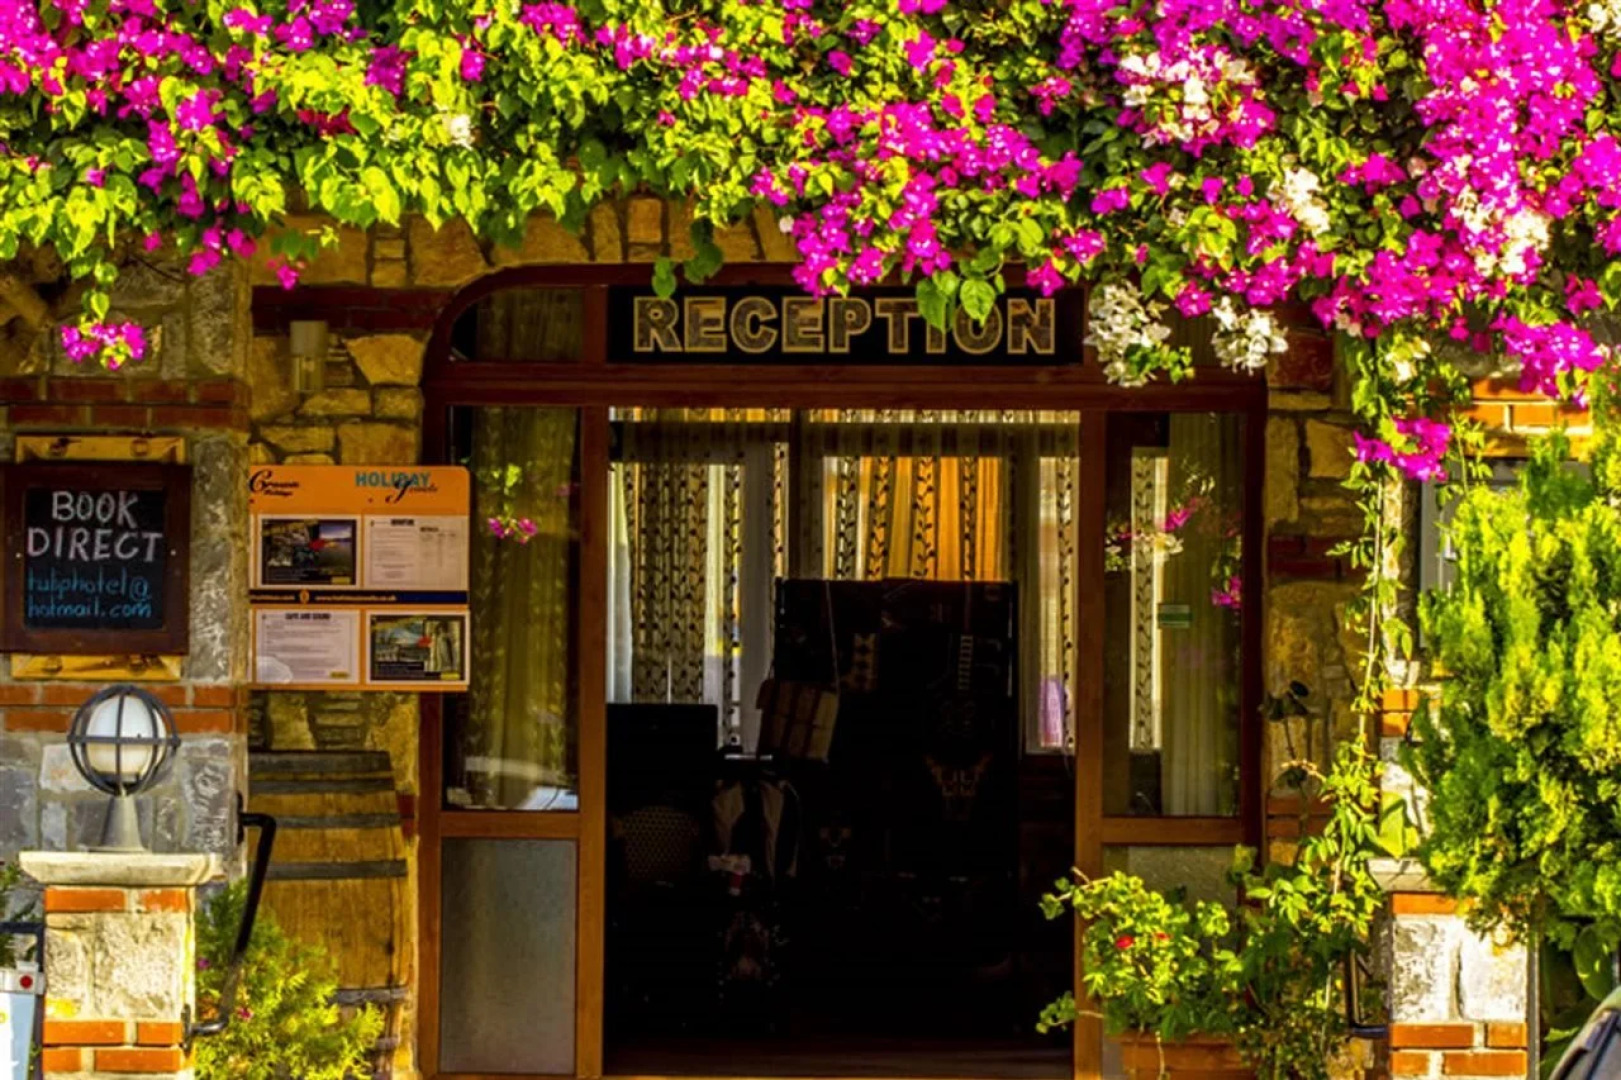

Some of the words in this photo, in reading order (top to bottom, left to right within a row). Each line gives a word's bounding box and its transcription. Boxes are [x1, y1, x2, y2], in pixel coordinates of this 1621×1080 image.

[355, 470, 431, 487] HOLIDAY
[51, 490, 138, 529] BOOK
[27, 526, 163, 562] DIRECT
[28, 594, 152, 619] hotmail.com
